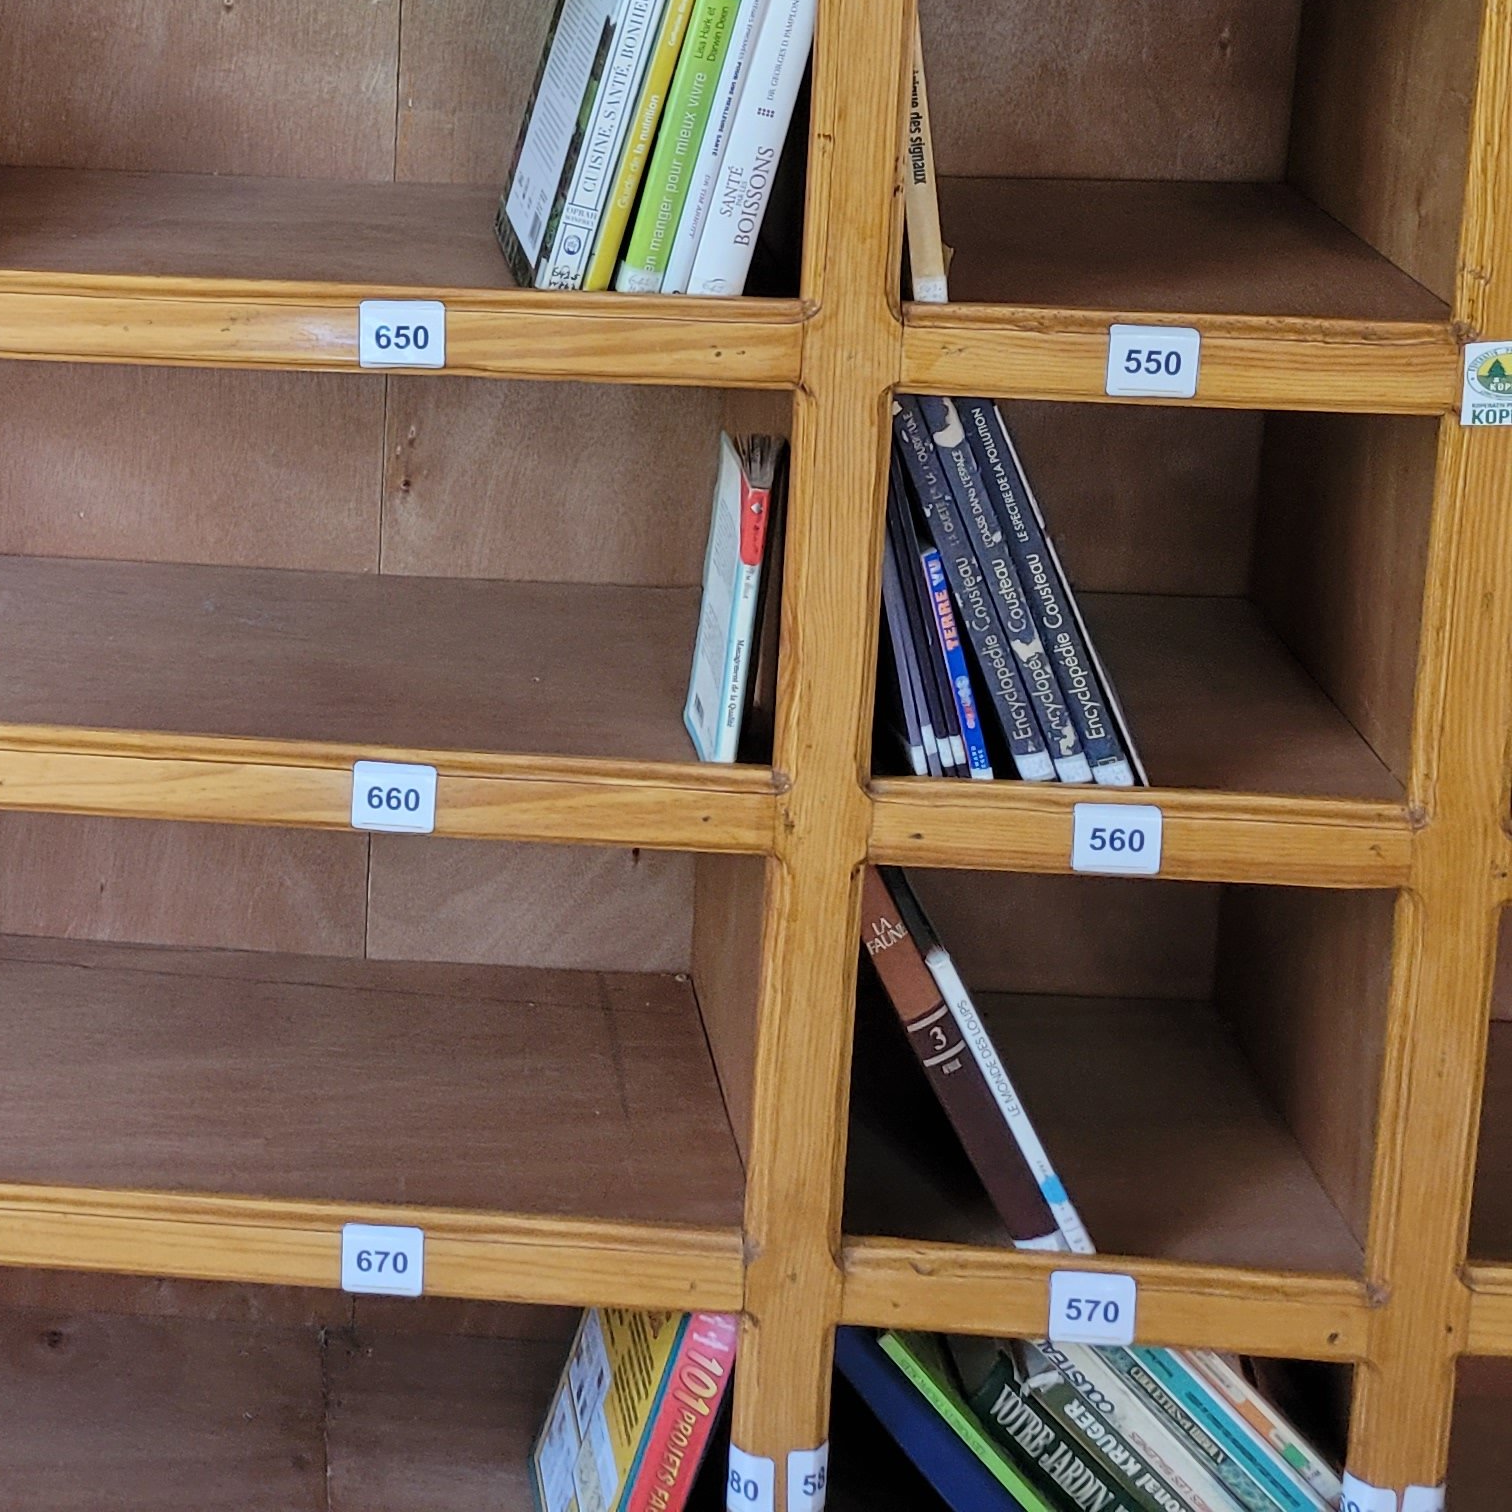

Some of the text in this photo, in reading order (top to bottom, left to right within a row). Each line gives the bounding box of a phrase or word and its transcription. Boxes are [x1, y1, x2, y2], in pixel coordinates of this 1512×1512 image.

[705, 30, 723, 62] Darwin
[580, 119, 616, 194] CUISINE,
[599, 59, 633, 121] SANTÉ,
[635, 91, 661, 142] nutrition
[648, 69, 707, 251] manger pour mieux vivre
[907, 111, 928, 186] des signaux
[717, 163, 745, 218] SANTÉ
[732, 143, 775, 248] BOISSONS
[375, 325, 429, 349] 650
[1124, 349, 1182, 376] 550
[969, 405, 1107, 741] Encyclopédie Cousteau LE SPECTRE DE LA POLLUTION
[984, 556, 1030, 635] Cousteau
[934, 588, 959, 650] TERRE
[977, 631, 1036, 742] Encyclopédie
[367, 786, 420, 812] 660
[1089, 827, 1145, 853] 560
[866, 921, 909, 957] FAUNE
[870, 916, 893, 937] LA
[928, 1025, 947, 1051] 3
[954, 998, 1021, 1119] LE MONDE DES LOUPS
[356, 1250, 408, 1274] 670
[1065, 1298, 1120, 1323] 570
[652, 1347, 727, 1489] 101 PROJETS
[986, 1382, 1116, 1512] VOTRE JARDIN
[1057, 1394, 1146, 1479] KRUGER
